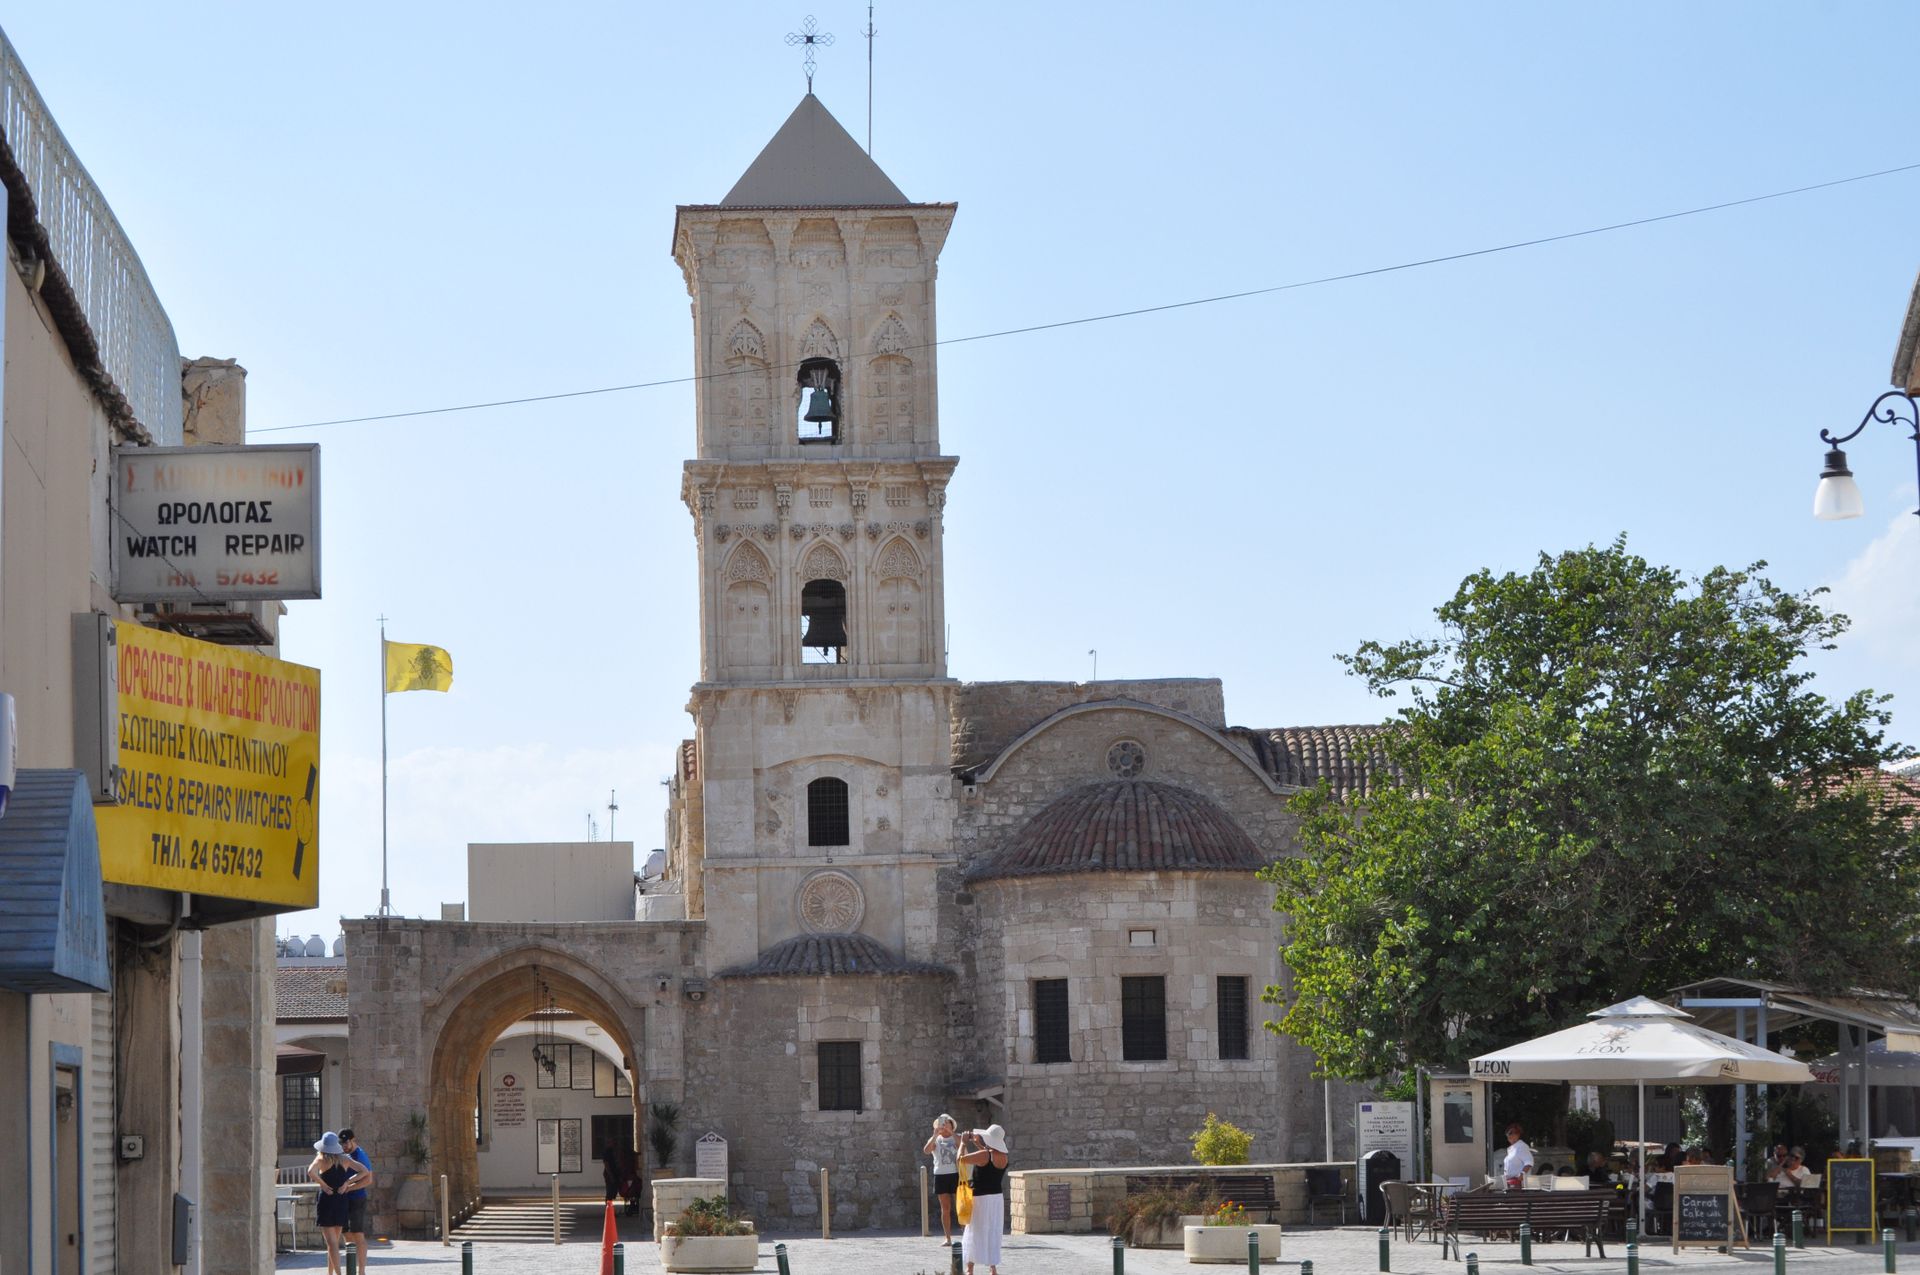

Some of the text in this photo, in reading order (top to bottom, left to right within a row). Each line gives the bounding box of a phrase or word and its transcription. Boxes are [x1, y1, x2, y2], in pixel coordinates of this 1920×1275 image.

[158, 501, 272, 525] ΩΡΟΛΟΓΑΣ
[127, 534, 305, 557] WATCH REPAIR
[117, 643, 184, 707] ΙΟΡΘΩΣΕΙΣ
[187, 659, 194, 708] &
[254, 673, 317, 733] ΩΡΟΛΟΓΙΩΝ
[120, 713, 289, 778] ΣΩΤΗΡΗΣ ΚΩΝΣΤΑΝΤΙΝΟΥ
[118, 767, 292, 830] SALES & REPAIRS WATCHES
[152, 833, 263, 878] ΤΗΛ. 24 657432
[1474, 1060, 1511, 1074] LEON
[1682, 1196, 1718, 1207] Carrot
[1682, 1208, 1704, 1217] Cake
